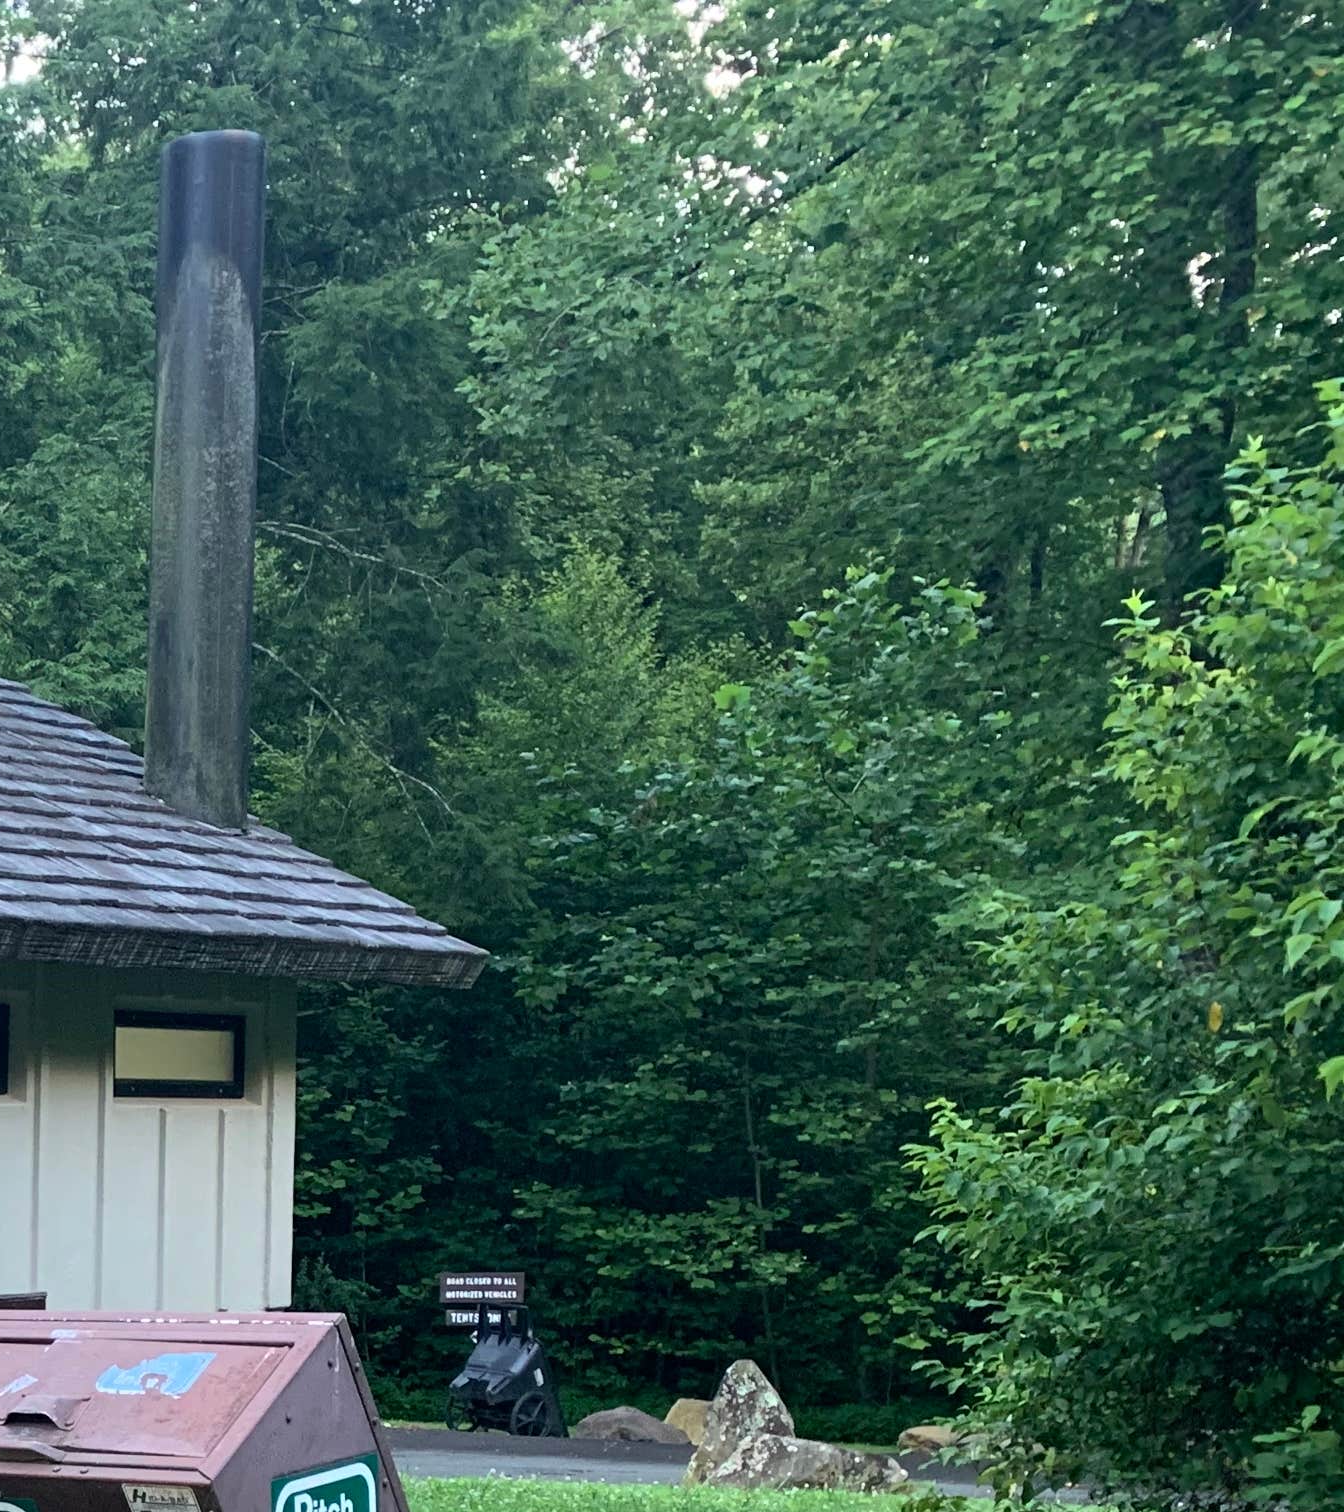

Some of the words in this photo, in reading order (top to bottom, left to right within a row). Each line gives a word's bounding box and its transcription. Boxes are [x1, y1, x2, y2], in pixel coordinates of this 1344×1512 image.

[446, 1277, 464, 1285] ROAD
[465, 1277, 491, 1285] CLOSED
[493, 1277, 503, 1285] TO
[504, 1277, 517, 1285] ALL
[445, 1290, 483, 1299] MOTORIZED
[484, 1290, 517, 1299] VEHICLES
[450, 1312, 480, 1323] TENTS
